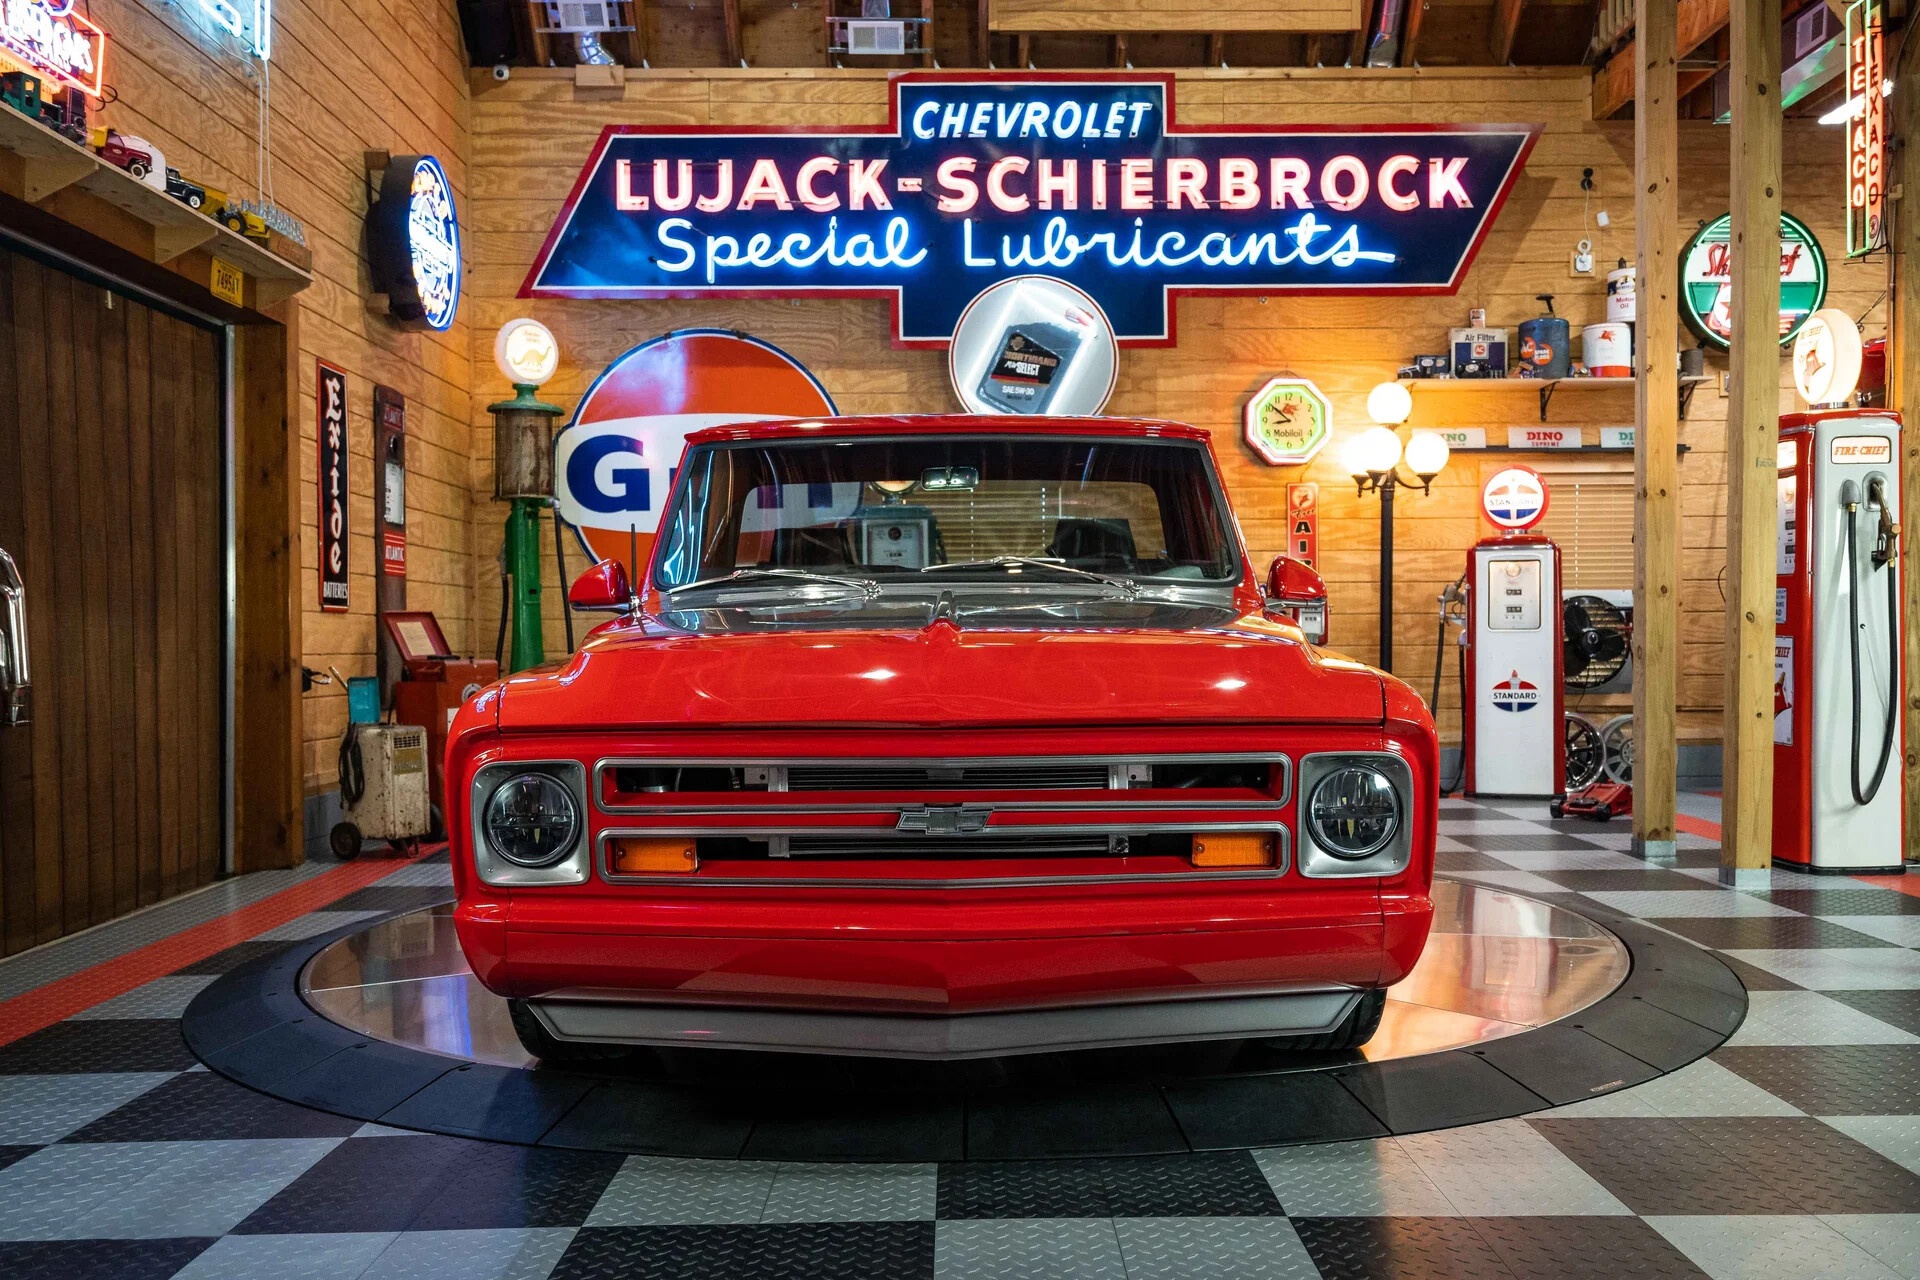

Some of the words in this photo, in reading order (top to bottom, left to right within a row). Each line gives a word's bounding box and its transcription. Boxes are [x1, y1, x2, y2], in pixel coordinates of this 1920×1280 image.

[912, 100, 1152, 140] CHEVROLET
[655, 216, 930, 284] Special
[964, 212, 1398, 268] Lubricants
[1702, 243, 1730, 277] Sk
[1273, 429, 1303, 437] Mobiloil
[1526, 432, 1563, 441] DINO
[1618, 432, 1634, 441] DI
[326, 378, 342, 574] Exide
[1292, 508, 1315, 518] Free
[323, 581, 348, 599] BATTERIES
[1493, 692, 1537, 700] STANDARD
